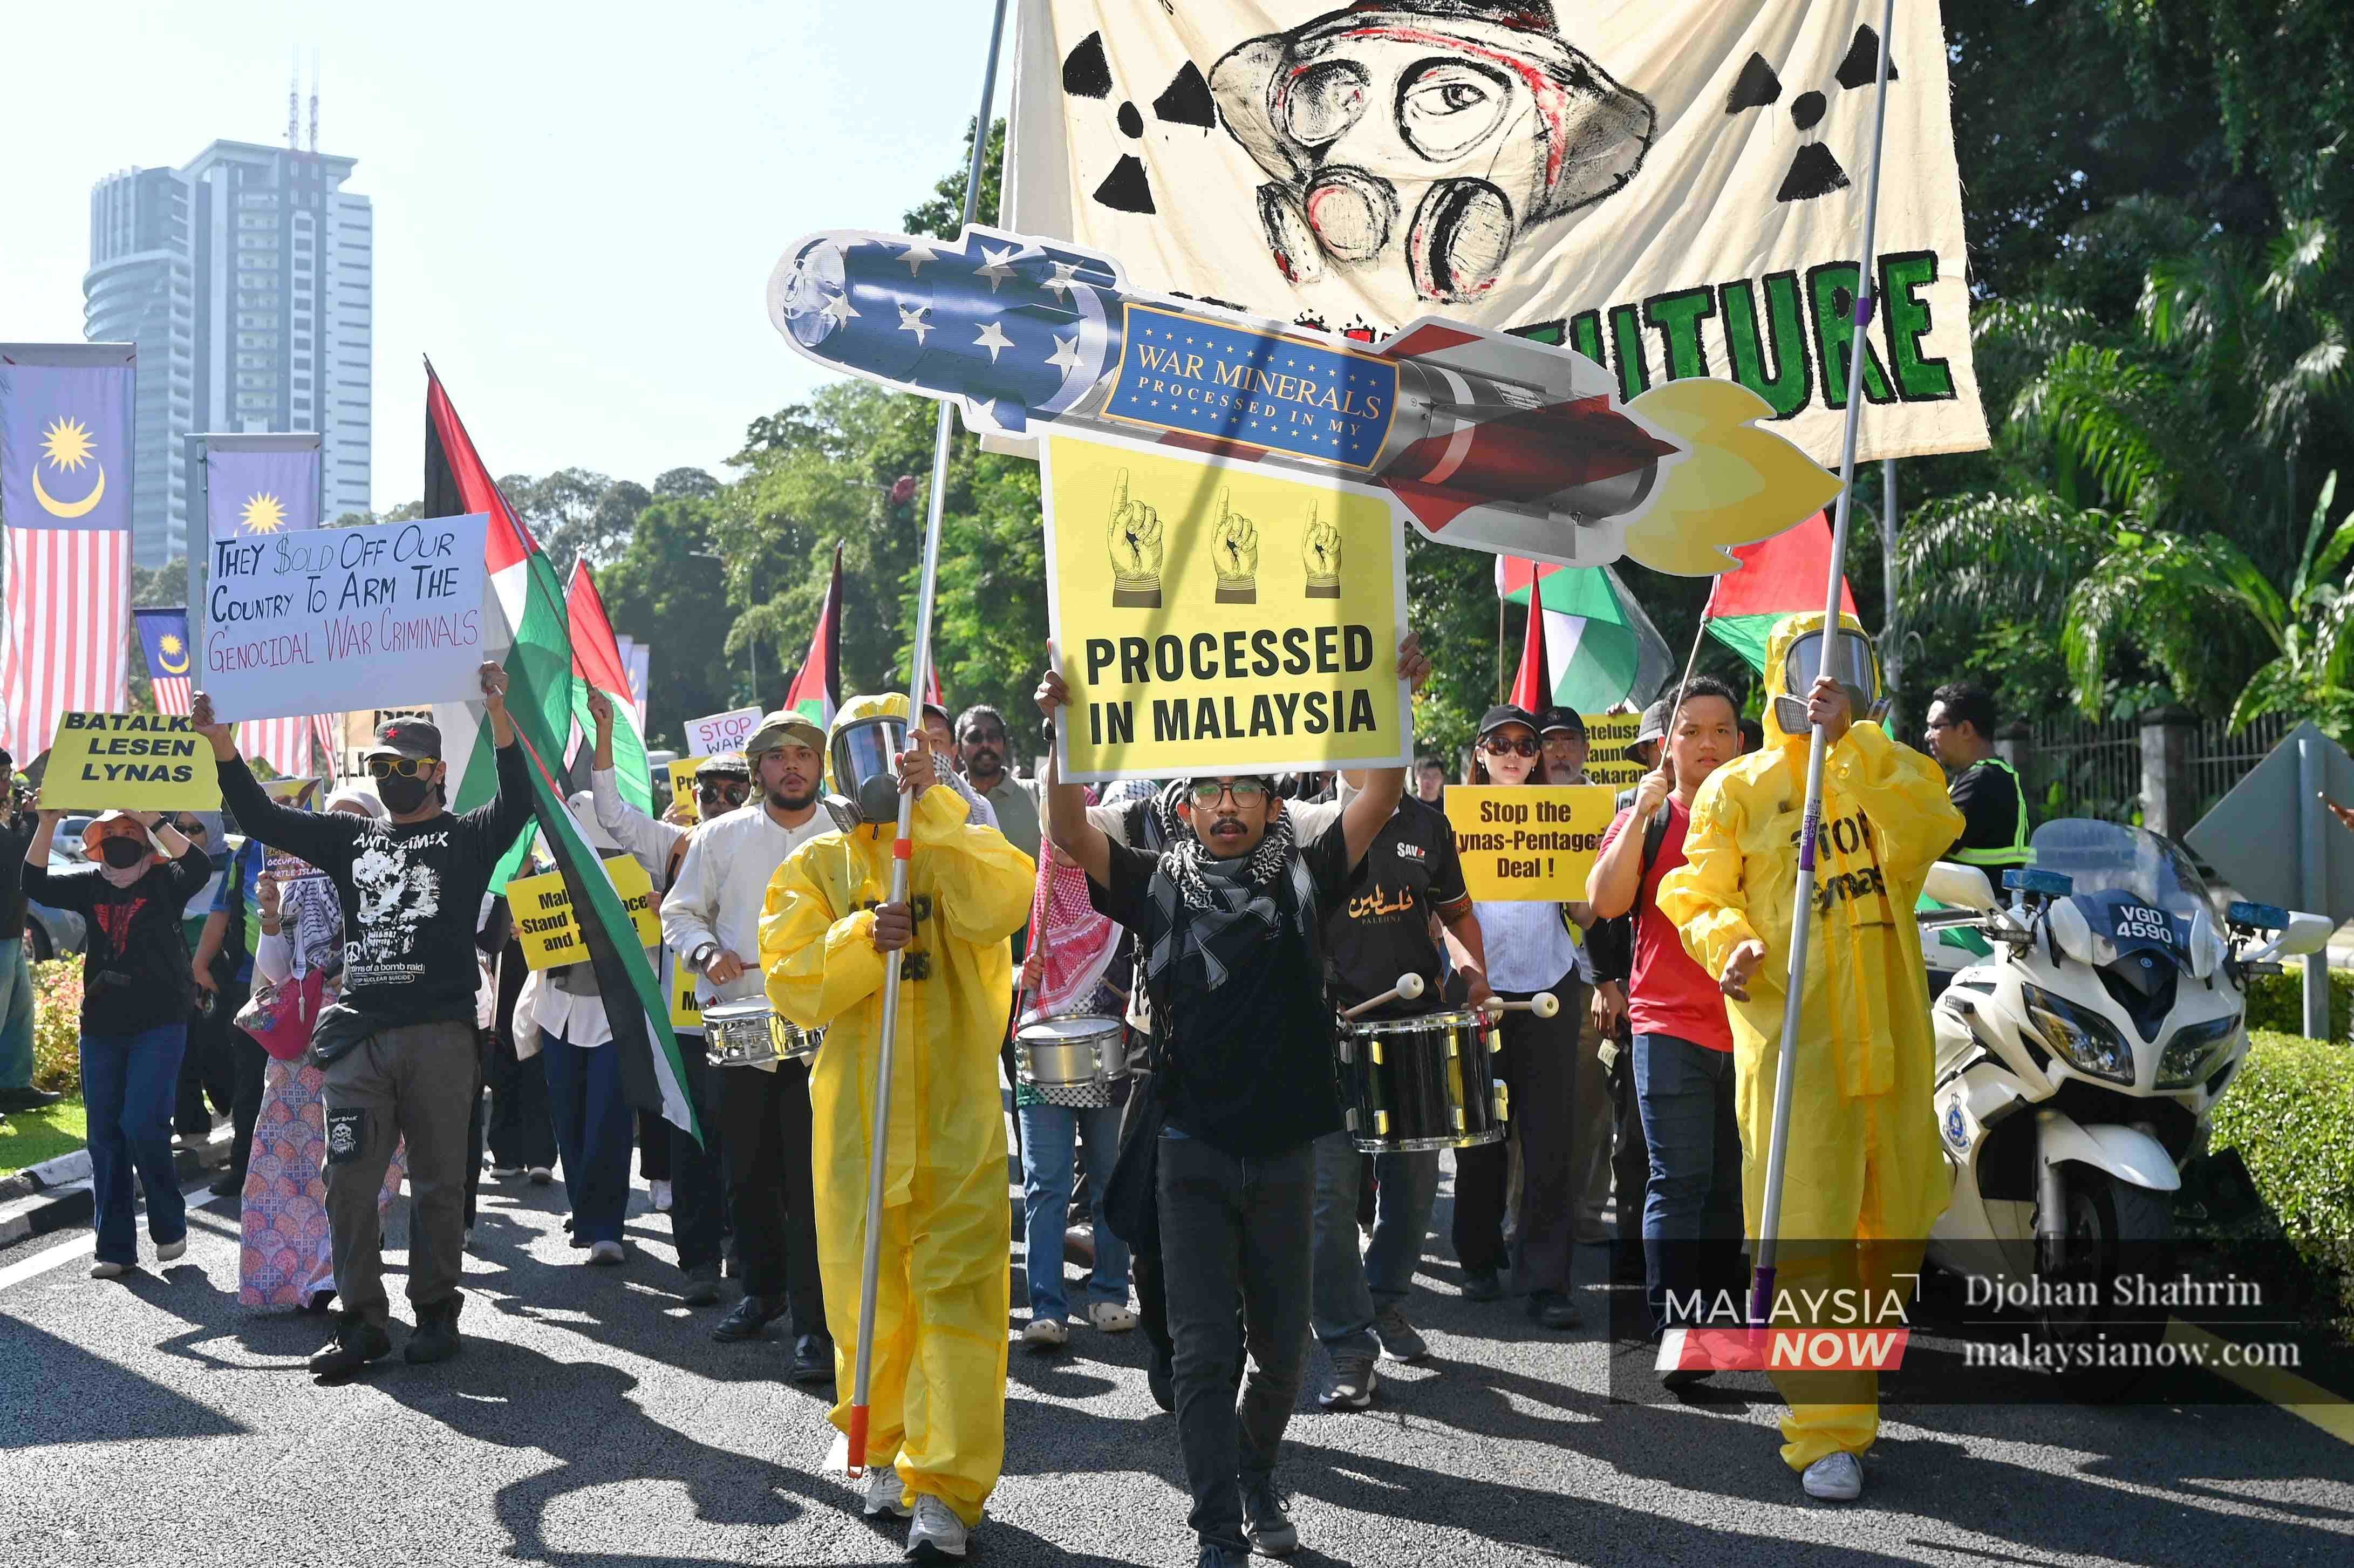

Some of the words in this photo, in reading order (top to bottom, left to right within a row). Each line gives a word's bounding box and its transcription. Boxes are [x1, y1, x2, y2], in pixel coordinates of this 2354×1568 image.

[1503, 250, 1954, 419] UTURE
[1137, 344, 1204, 380] WAR
[1212, 360, 1381, 420] MINERALS
[1138, 377, 1276, 417] PROCESSED
[1291, 411, 1314, 426] IN
[1329, 419, 1360, 436] MY
[216, 540, 265, 578] THEY
[341, 533, 387, 569] OFF
[394, 524, 454, 562] OUR
[211, 585, 294, 622] COUNTRY
[308, 576, 326, 613] TO
[338, 571, 395, 611] ARM
[411, 565, 459, 600] THE
[209, 631, 314, 673] GENOCIDAL
[324, 615, 372, 661] WAR
[381, 607, 477, 652] CRIMINALS
[1086, 625, 1373, 685] PROCESSED
[1090, 701, 1134, 745] IN
[1153, 688, 1377, 741] MALAYSIA
[699, 717, 751, 741] STOP
[88, 738, 195, 756] LESEN
[707, 735, 744, 754] WAR
[81, 763, 192, 782] LYNAS
[1480, 801, 1528, 824] Stop
[1536, 801, 1571, 822] the
[1497, 858, 1540, 878] Deal
[1349, 883, 1413, 918] فلسطين
[522, 911, 568, 935] Stand
[2120, 905, 2163, 925] VGD
[543, 932, 574, 951] and
[2117, 922, 2172, 943] 4590
[381, 963, 405, 971] bomb
